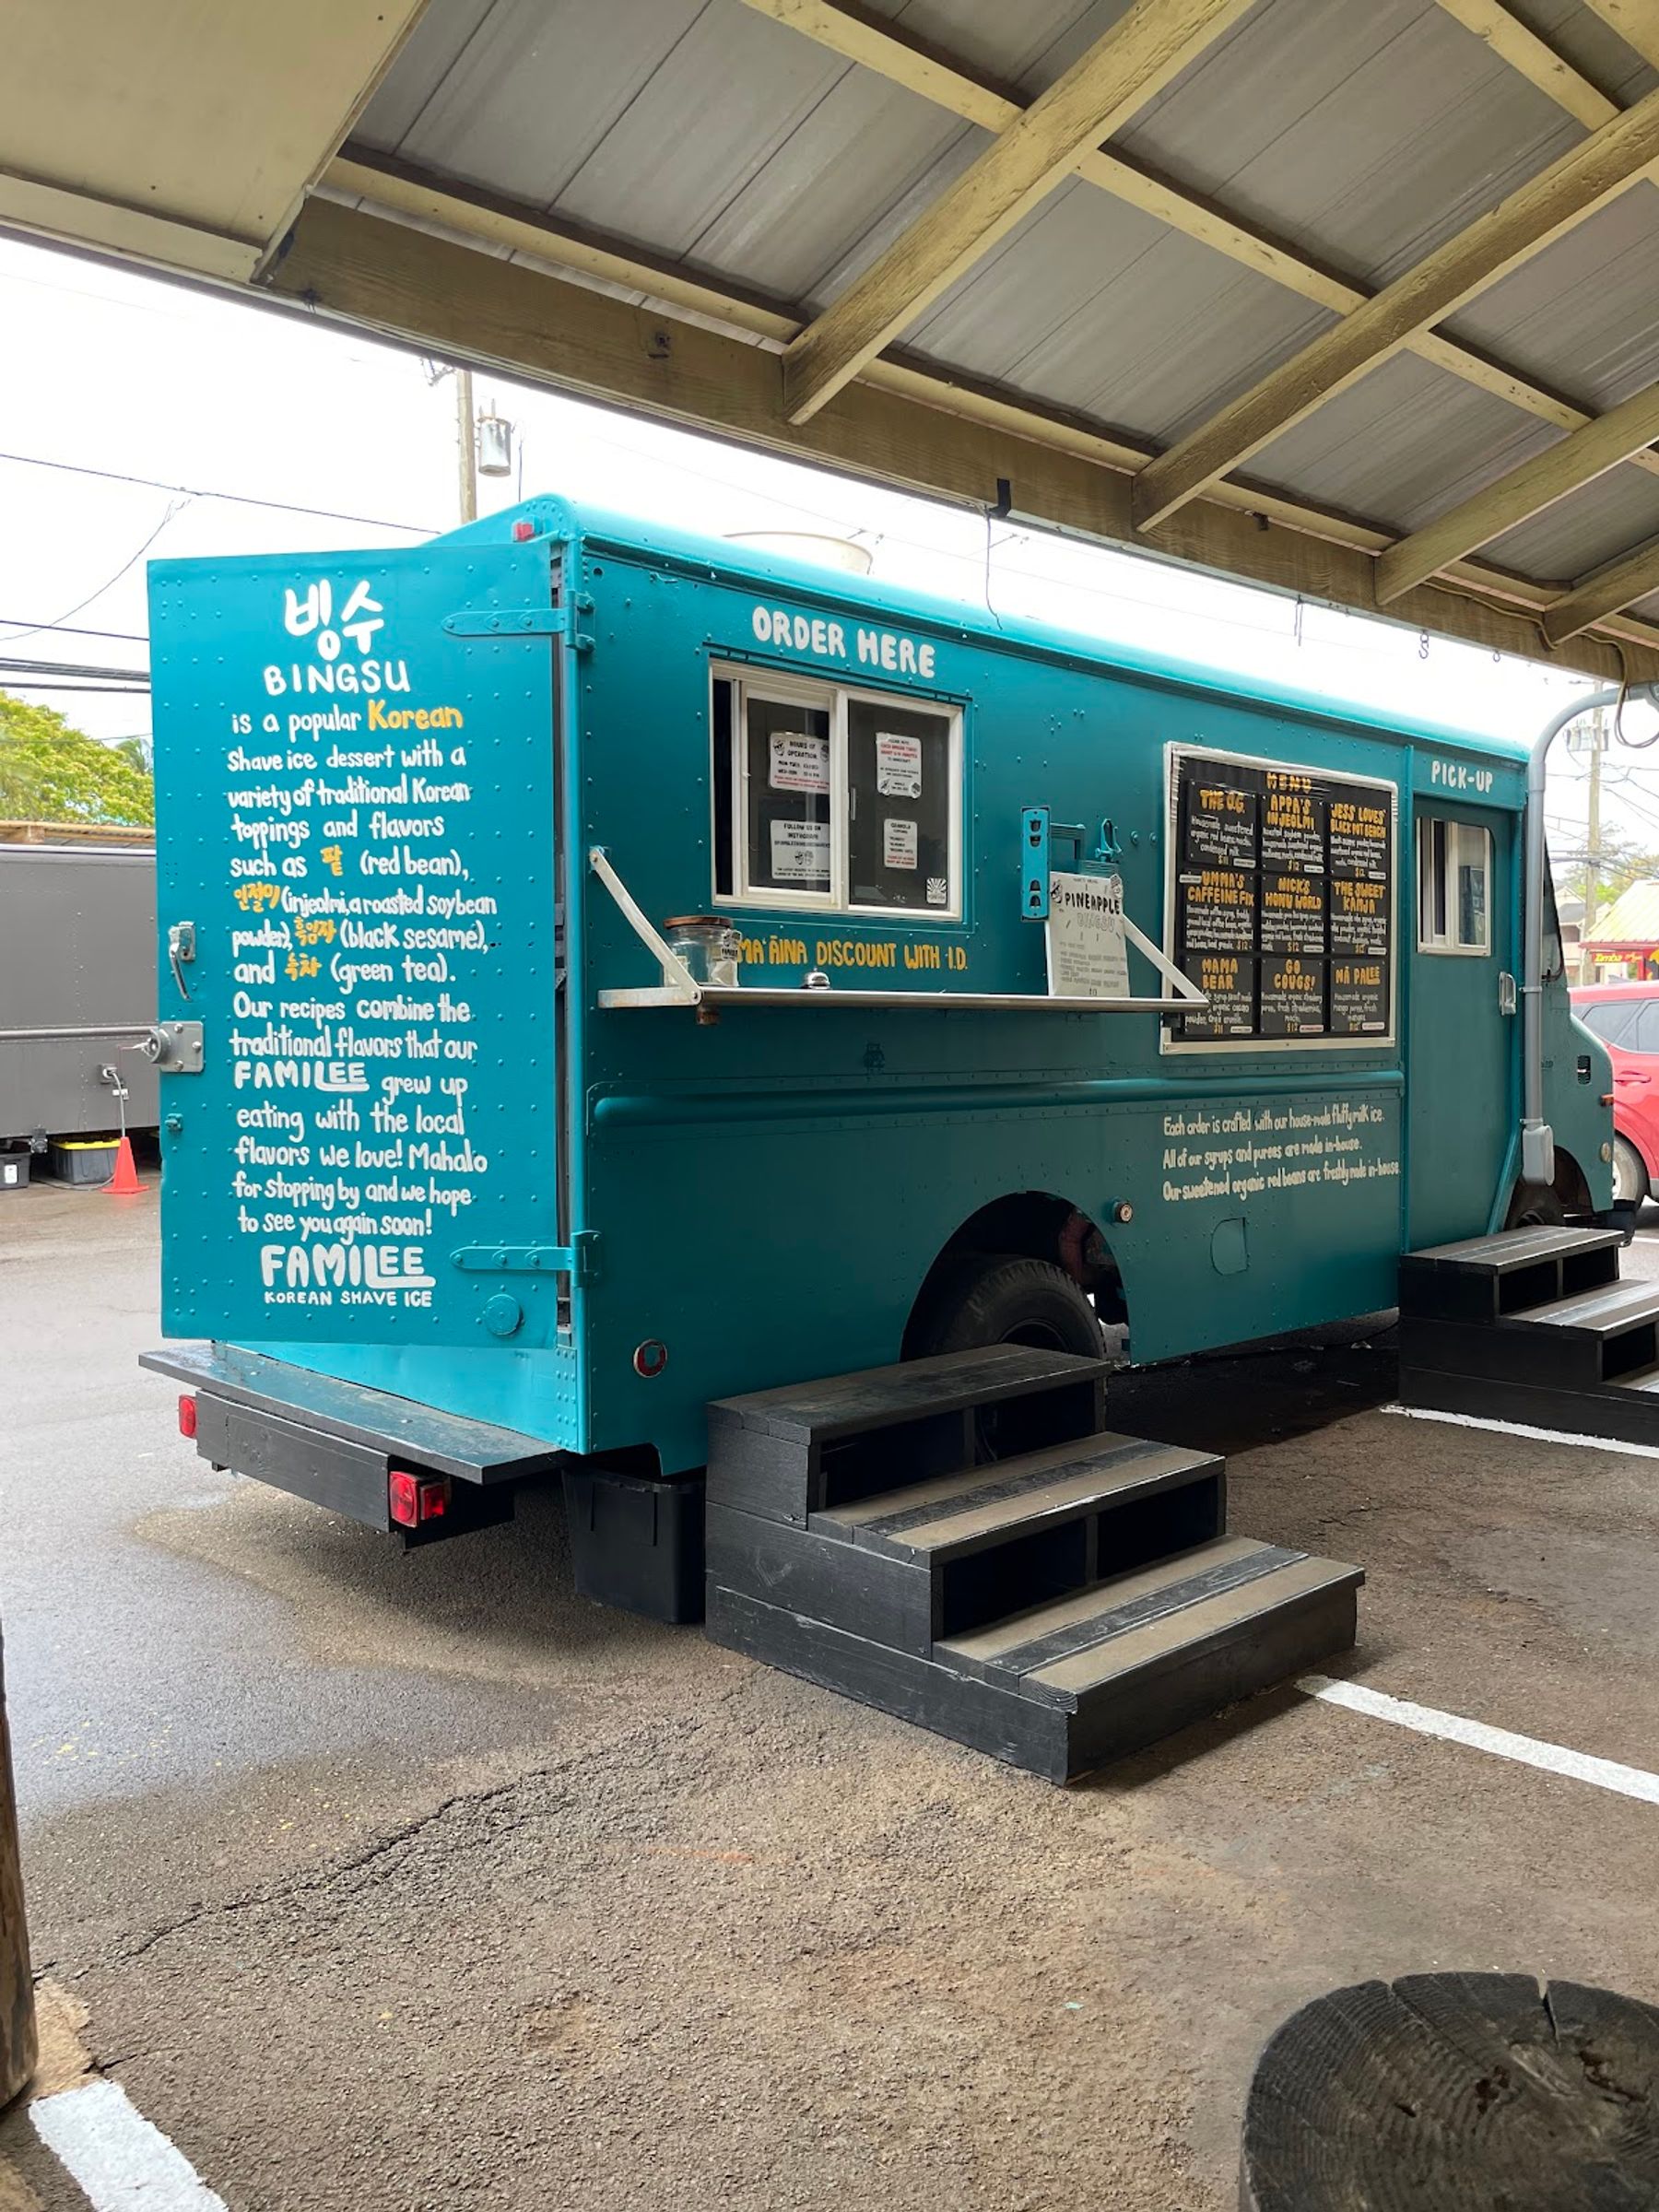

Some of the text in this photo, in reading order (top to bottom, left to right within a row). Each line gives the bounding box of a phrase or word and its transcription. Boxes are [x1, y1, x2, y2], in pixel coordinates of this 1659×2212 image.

[285, 579, 384, 661] 빙수
[753, 606, 935, 677] ORDER HERE
[264, 660, 410, 696] BINGSU
[233, 700, 463, 743] is a popular Korean
[288, 750, 317, 770] ice
[326, 745, 394, 768] dessert
[401, 739, 443, 767] with
[451, 747, 466, 765] a
[1432, 760, 1492, 793] PICK-UP
[228, 773, 470, 816] variety of traditional Korean
[1200, 790, 1224, 810] THE
[1271, 794, 1312, 816] APPA'S
[231, 809, 444, 853] toppings and flavors
[1267, 812, 1314, 830] INJEOLMI
[1332, 804, 1385, 825] JESS LOVES
[230, 849, 276, 877] such
[282, 856, 307, 877] as
[360, 846, 400, 875] (red
[404, 845, 468, 880] bean),
[1187, 886, 1254, 907] CAFFEINE FIX
[1202, 871, 1245, 889] UMMA'S
[1334, 881, 1383, 900] THE SWEET
[349, 898, 361, 913] a
[363, 885, 423, 914] roasted
[427, 889, 497, 919] soybean
[1065, 892, 1120, 915] PINEAPPLE
[1295, 894, 1322, 910] WORLD
[340, 919, 400, 948] (black
[403, 920, 488, 953] sesame),
[234, 950, 275, 983] and
[331, 953, 393, 994] (green
[402, 953, 455, 982] tea).
[817, 940, 897, 969] DISCOUNT
[905, 944, 941, 970] WITH
[947, 944, 968, 971] I.D.
[1202, 959, 1238, 973] MAMA
[1286, 959, 1300, 974] GO
[1203, 974, 1233, 989] BEAR
[1274, 973, 1315, 991] COUGS!
[234, 992, 470, 1030] Our recipes combine the
[229, 1022, 477, 1059] traditional flavors that our
[235, 1060, 467, 1109] FAMILEE grew up
[237, 1099, 465, 1142] eating with the local
[1164, 1113, 1185, 1136] Each
[1187, 1112, 1210, 1135] order
[1212, 1115, 1220, 1134] is
[1222, 1109, 1251, 1133] crafted
[1254, 1109, 1273, 1131] with
[1275, 1117, 1288, 1130] our
[1289, 1107, 1331, 1128] house-made
[1332, 1102, 1352, 1130] fluffy
[234, 1135, 487, 1172] flavors we love! Mahalo
[1163, 1134, 1362, 1171] All of our syrups and purees are made in-house.
[232, 1171, 262, 1198] for
[337, 1177, 359, 1209] by
[366, 1176, 398, 1202] and
[401, 1185, 426, 1202] we
[429, 1180, 471, 1217] hope
[1163, 1181, 1182, 1201] Our
[1182, 1171, 1230, 1200] sweetened
[1232, 1171, 1265, 1201] organic
[1267, 1168, 1281, 1188] red
[1282, 1167, 1306, 1186] beans
[1308, 1170, 1321, 1182] are
[1349, 1158, 1366, 1179] made
[238, 1206, 431, 1245] to see you again soon!
[261, 1244, 436, 1288] FAMILEE
[265, 1290, 431, 1307] KOREAN SHAVE ICE
